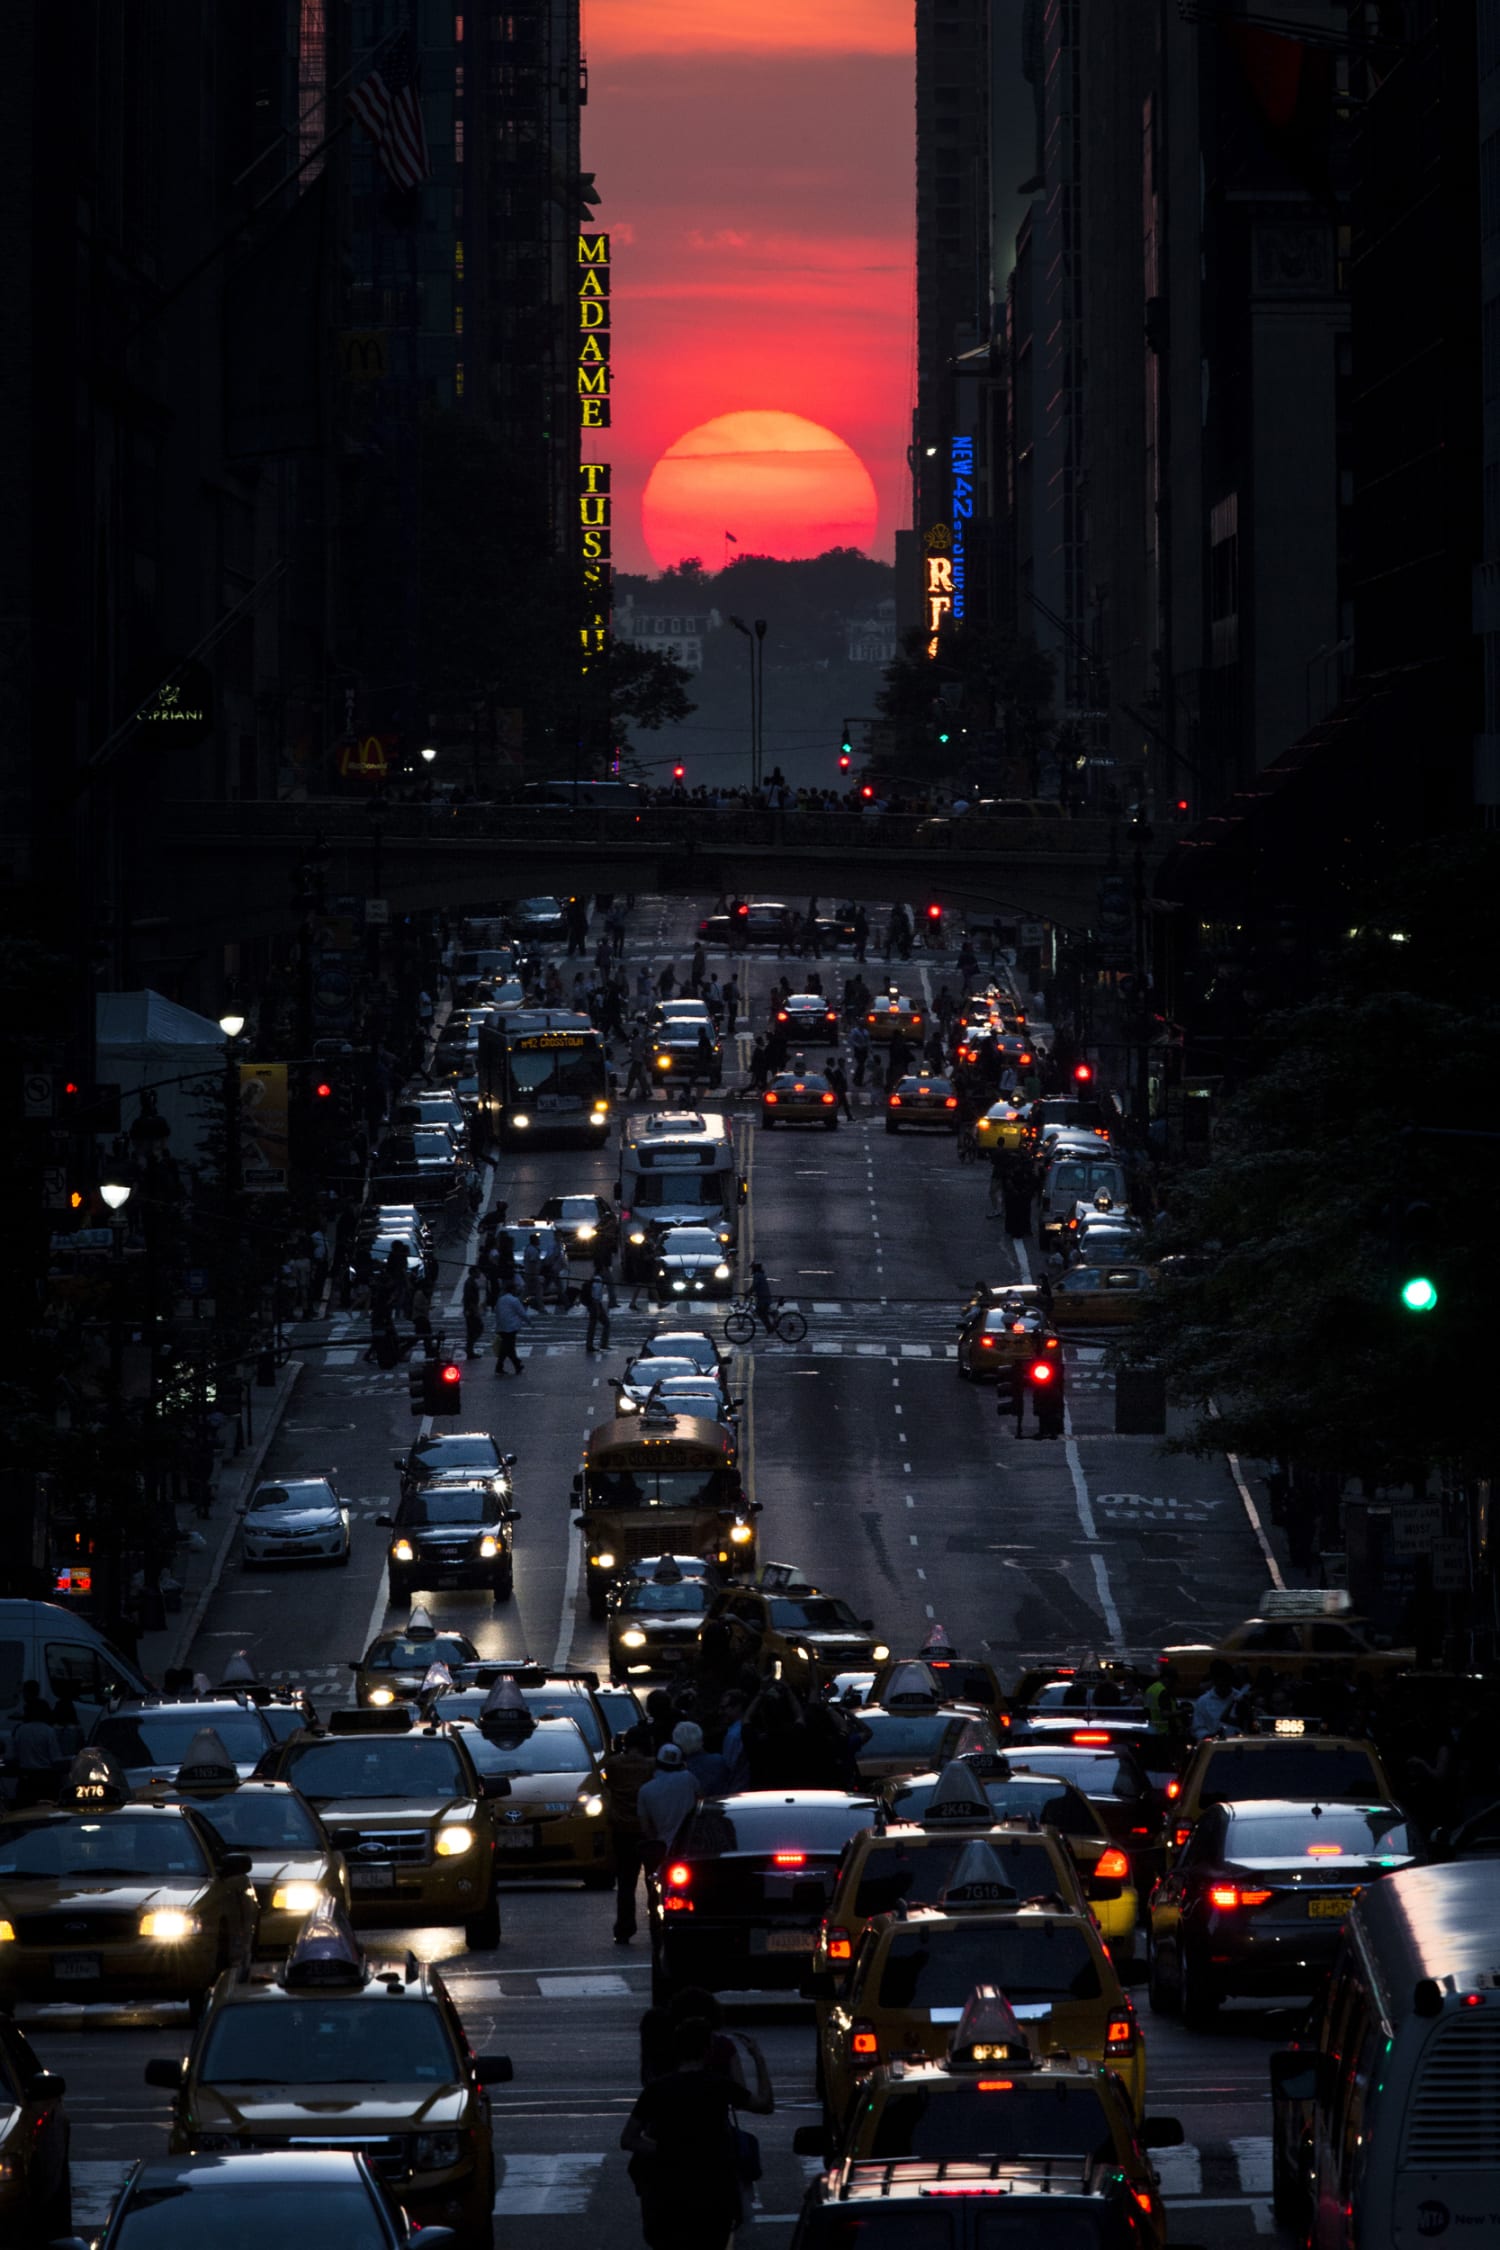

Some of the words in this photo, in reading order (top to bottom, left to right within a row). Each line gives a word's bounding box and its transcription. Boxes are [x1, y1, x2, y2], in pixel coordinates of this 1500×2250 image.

[576, 235, 608, 427] MADAME
[951, 435, 973, 475] NEW
[952, 477, 974, 519] 42
[1096, 1493, 1224, 1509] ONLY
[1104, 1509, 1209, 1520] BUS
[75, 1784, 105, 1798] 2Y76
[941, 1802, 972, 1816] 2K42
[1456, 2213, 1485, 2225] New
